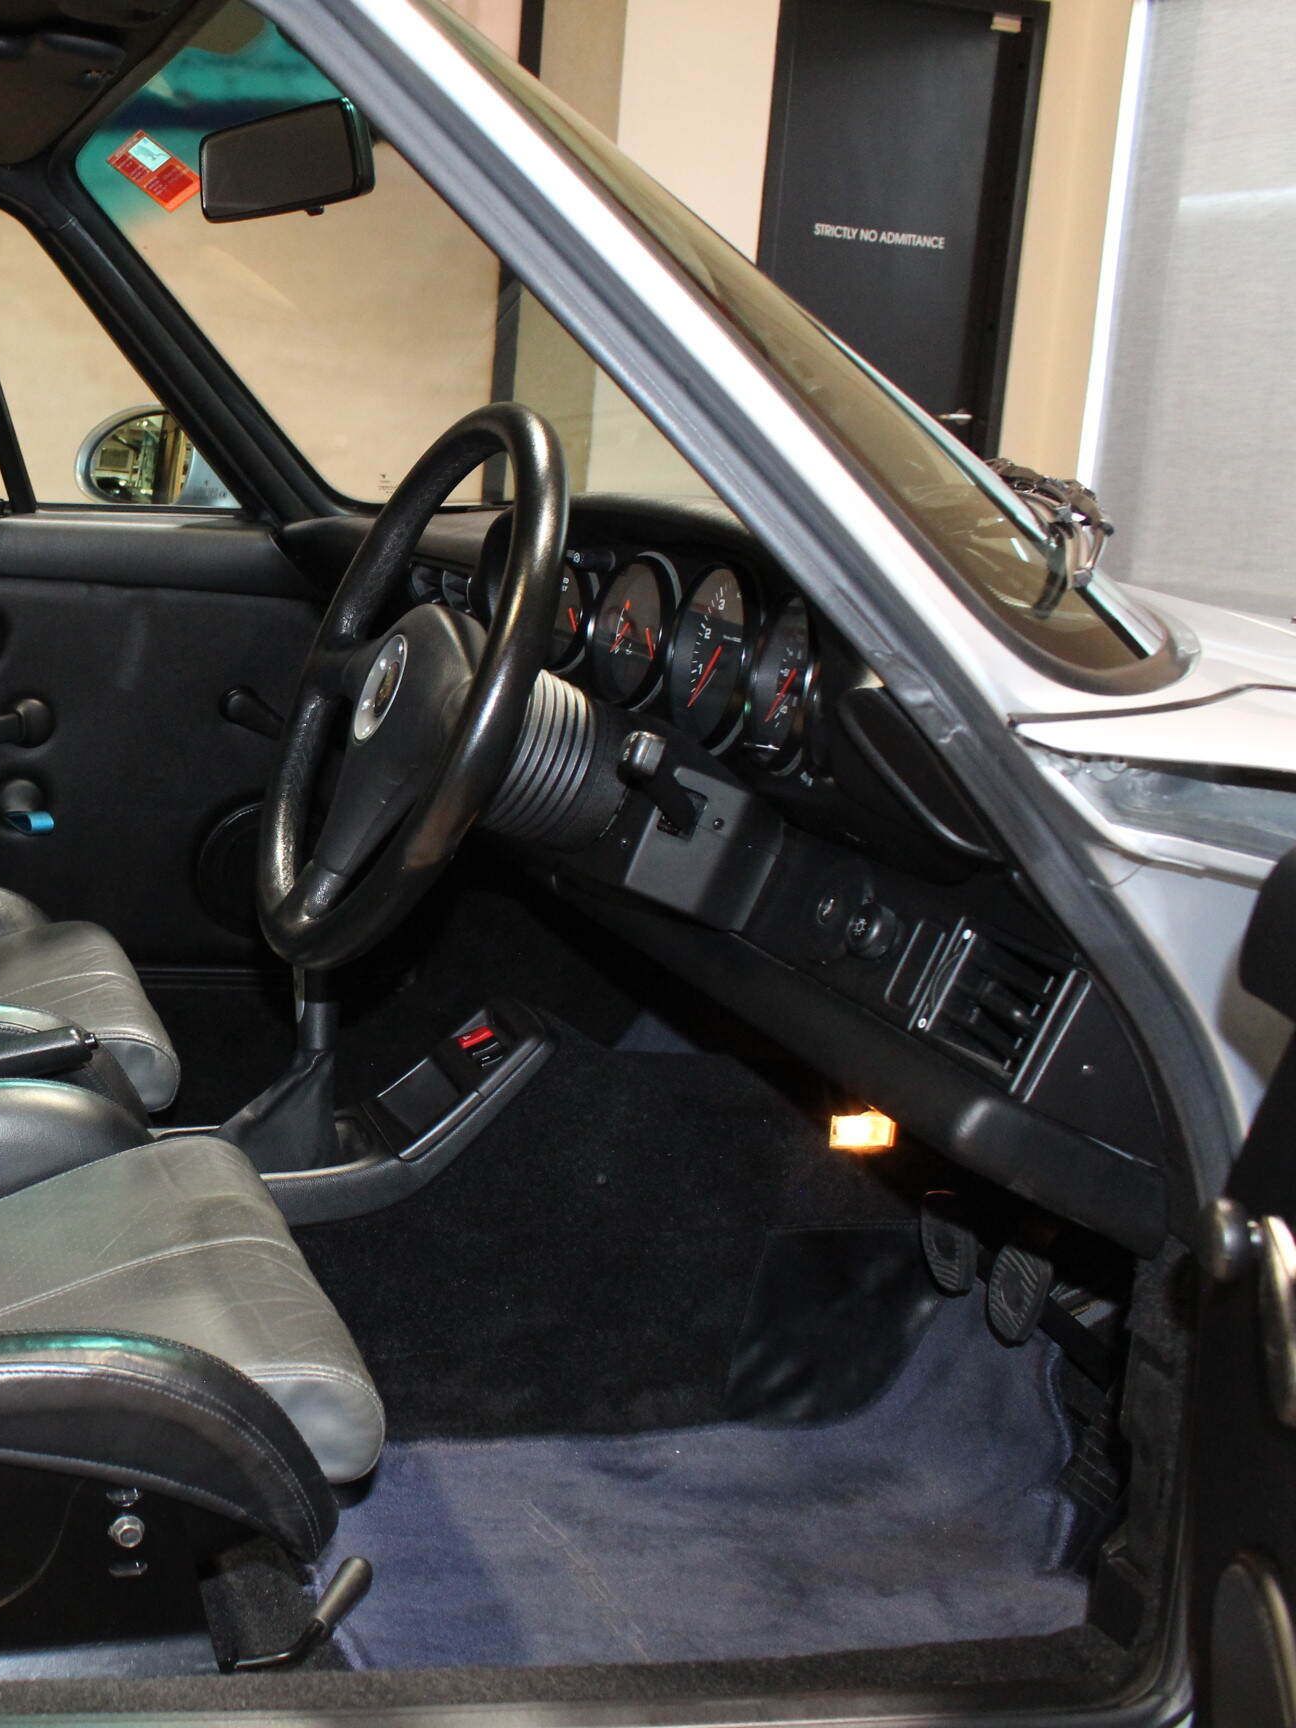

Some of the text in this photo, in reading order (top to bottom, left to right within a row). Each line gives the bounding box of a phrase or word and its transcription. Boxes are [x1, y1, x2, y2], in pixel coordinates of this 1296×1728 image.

[814, 222, 945, 250] STRICTLY NO ADMITTANCE
[718, 599, 725, 610] 3
[704, 628, 712, 639] 2
